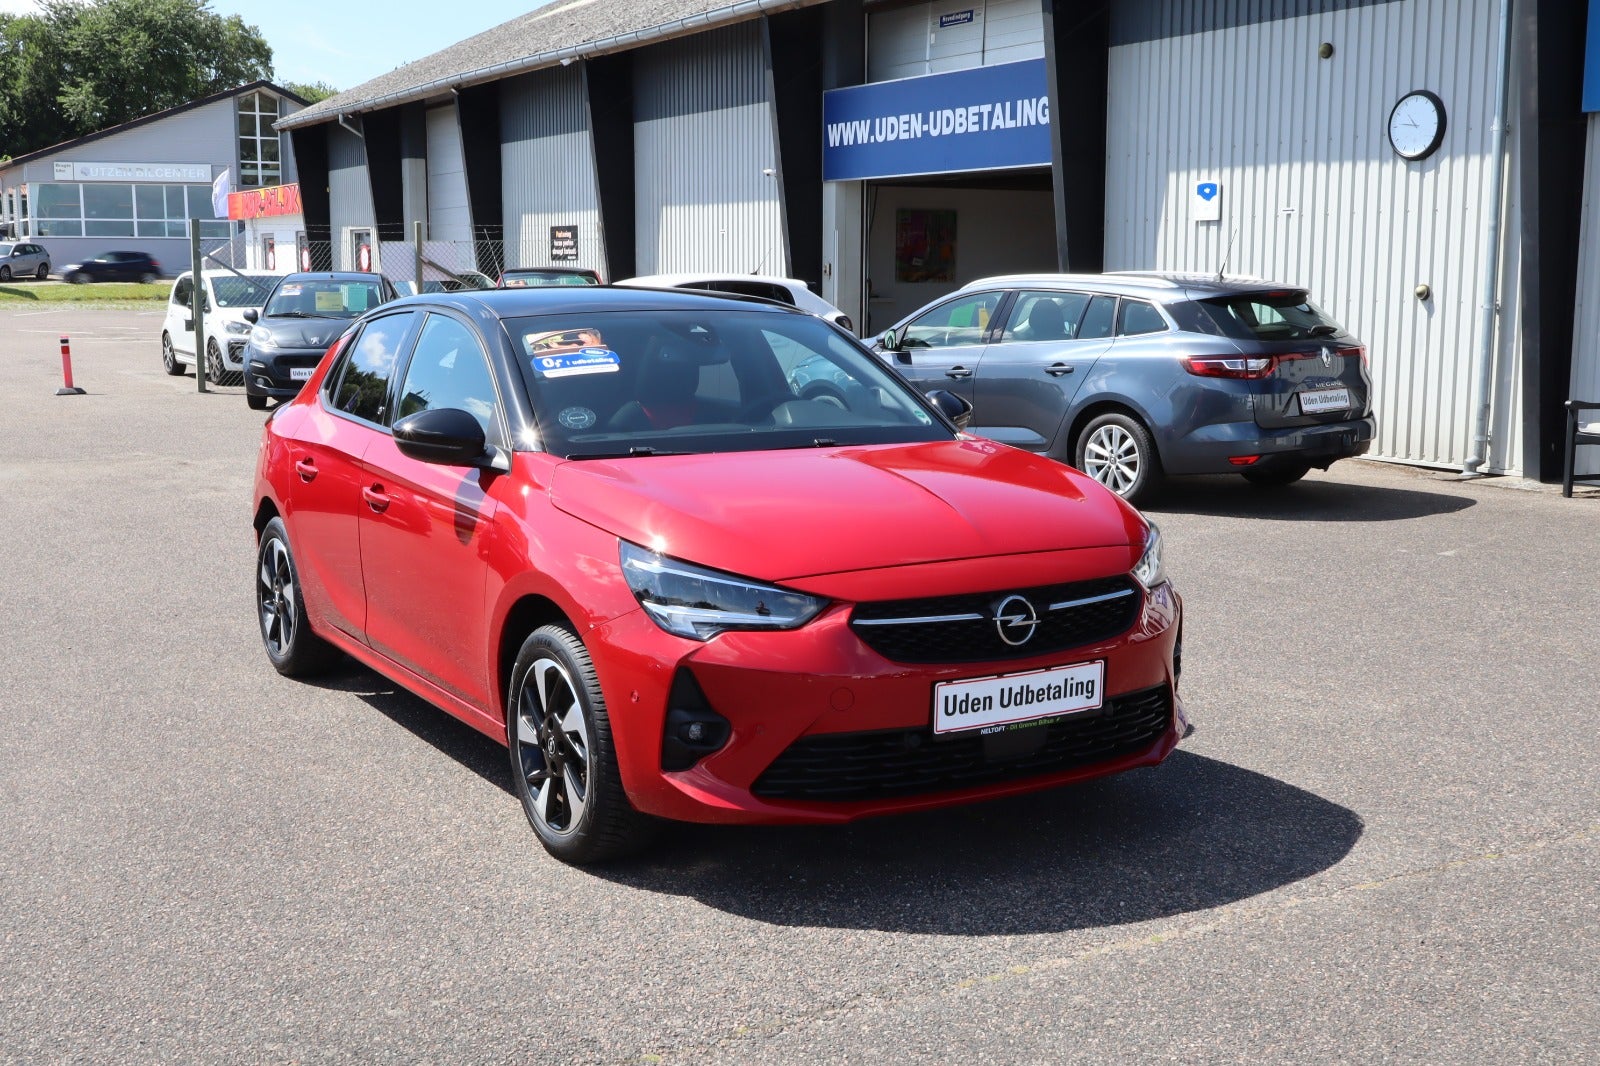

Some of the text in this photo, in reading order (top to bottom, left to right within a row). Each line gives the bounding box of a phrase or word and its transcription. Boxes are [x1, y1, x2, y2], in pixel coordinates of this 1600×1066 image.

[1303, 393, 1348, 406] Uden Udbetaling
[944, 677, 1095, 717] Uden Udbetaling
[980, 725, 1006, 735] NELTOFT
